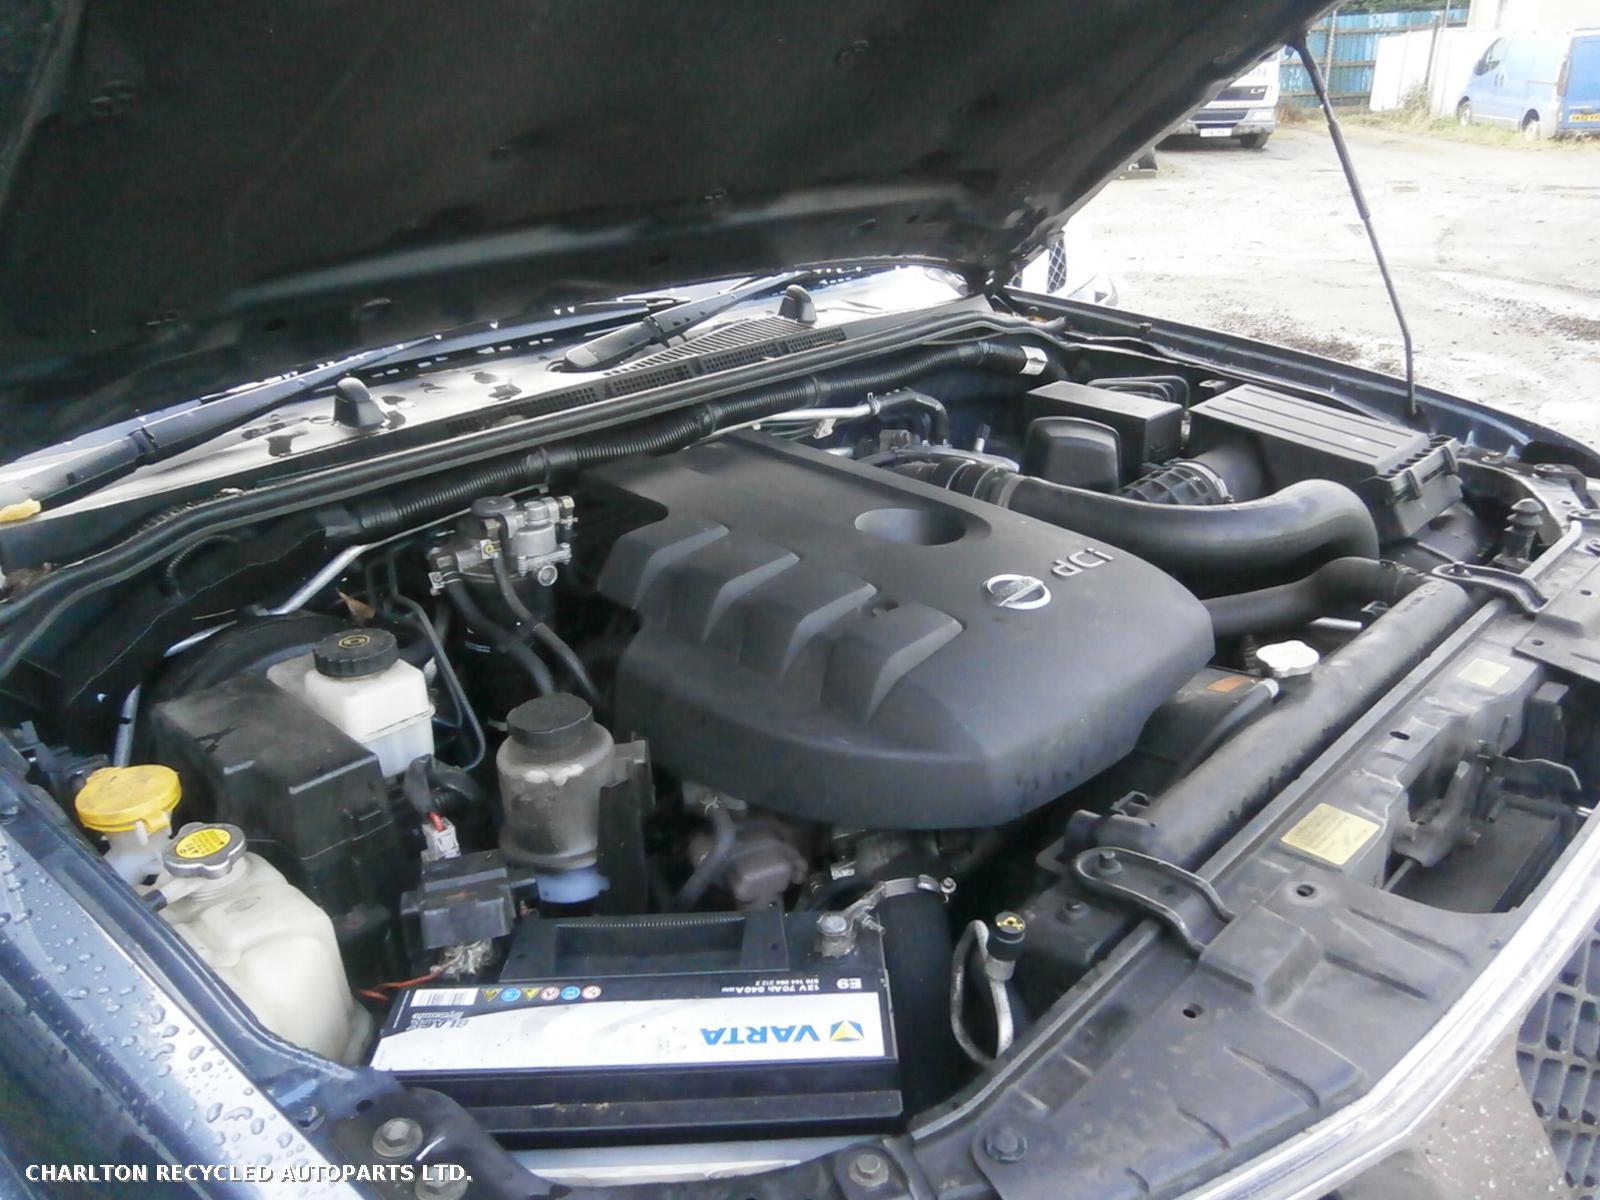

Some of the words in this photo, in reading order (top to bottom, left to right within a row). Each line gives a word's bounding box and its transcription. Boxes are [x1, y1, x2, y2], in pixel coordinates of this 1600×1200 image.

[836, 978, 862, 989] E9
[406, 1018, 469, 1030] BLACK
[699, 1024, 820, 1046] VARTA
